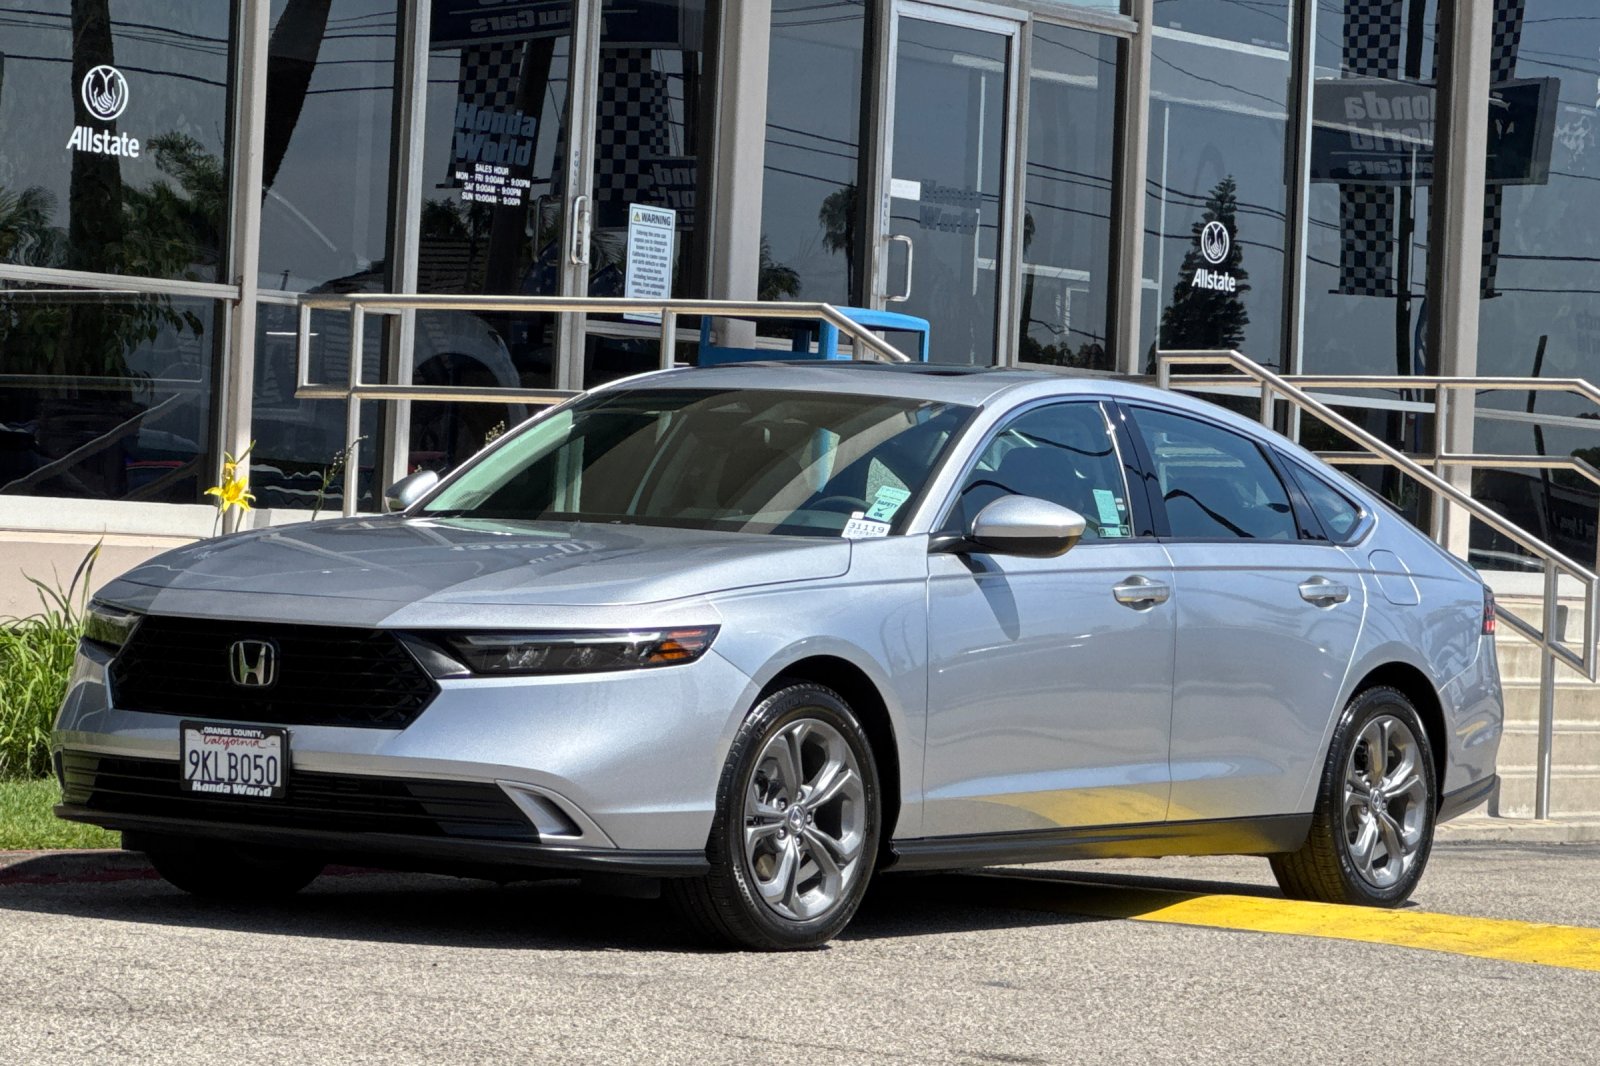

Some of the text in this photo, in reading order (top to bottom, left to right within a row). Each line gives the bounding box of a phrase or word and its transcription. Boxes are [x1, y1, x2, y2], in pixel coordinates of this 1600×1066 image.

[455, 102, 537, 138] Honda
[66, 125, 140, 158] Allstate
[455, 132, 533, 166] World
[475, 163, 492, 174] SALES
[456, 171, 469, 180] MON
[475, 173, 484, 183] FRI
[485, 175, 505, 185] 9:00AM
[511, 178, 531, 188] 9:00PM
[462, 192, 473, 200] SUN
[502, 187, 521, 197] 9:00PM
[641, 213, 671, 226] WARNING
[1191, 268, 1236, 292] Allstate
[849, 522, 885, 533] 31119
[204, 726, 262, 738] ORANGE COUNTY
[203, 735, 266, 750] California
[188, 749, 278, 786] 9KLB050
[192, 781, 231, 794] Honda
